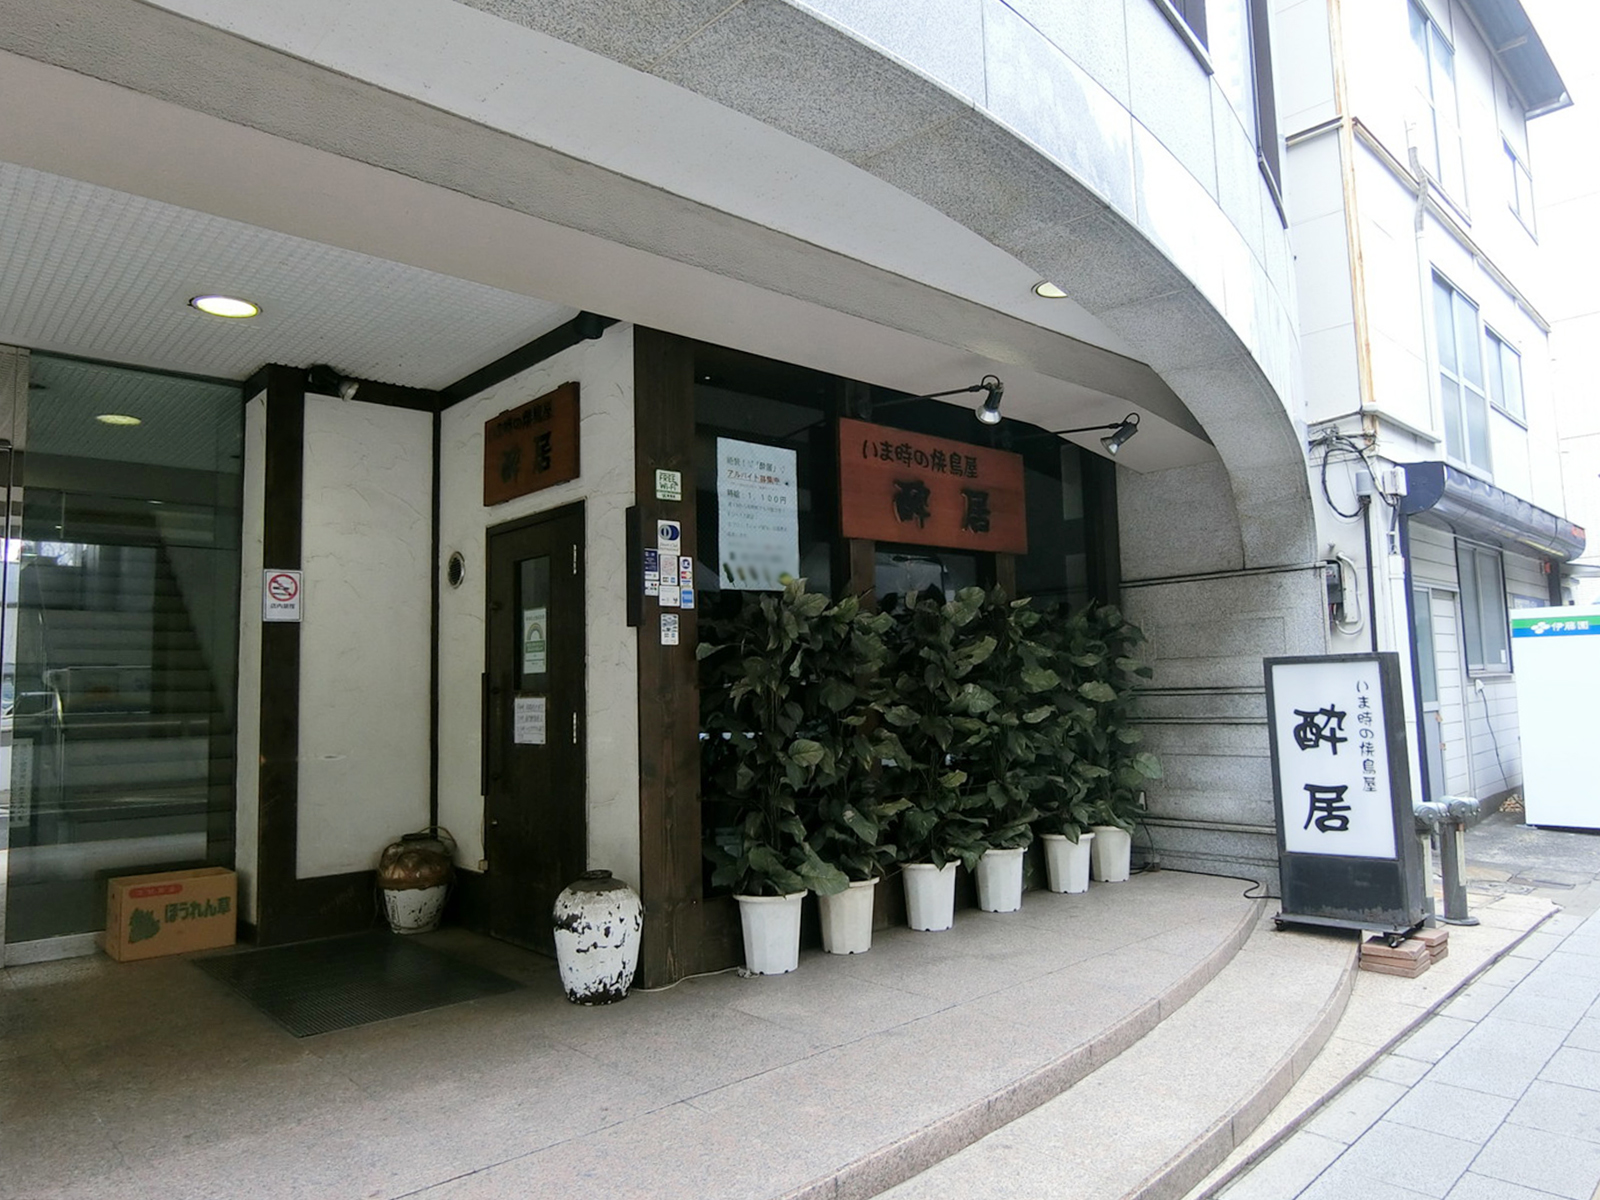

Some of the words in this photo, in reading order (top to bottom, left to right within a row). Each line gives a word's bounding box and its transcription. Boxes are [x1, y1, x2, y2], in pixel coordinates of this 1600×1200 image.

[659, 471, 676, 483] FREE
[863, 439, 978, 479] いま時の焼鳥屋
[1293, 703, 1352, 834] 酔居
[1356, 679, 1378, 793] いま時の焼鳥屋
